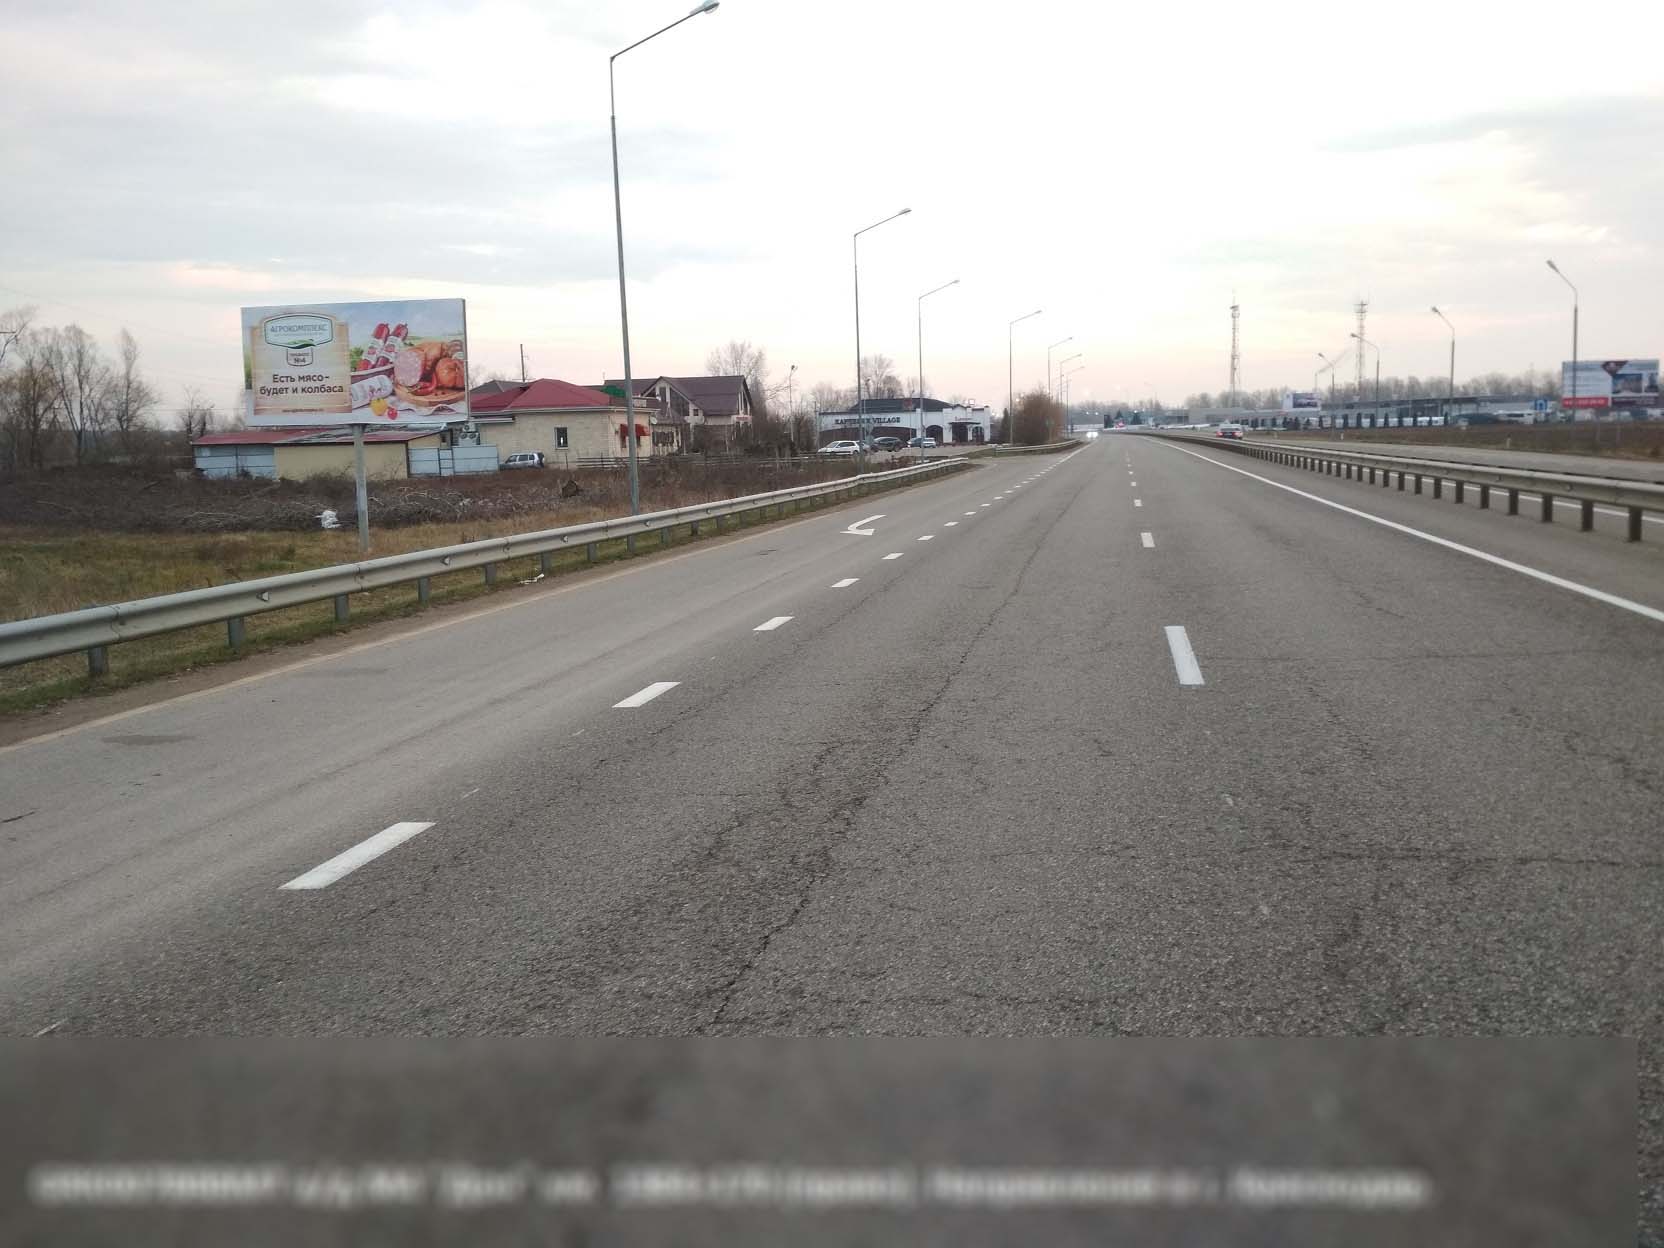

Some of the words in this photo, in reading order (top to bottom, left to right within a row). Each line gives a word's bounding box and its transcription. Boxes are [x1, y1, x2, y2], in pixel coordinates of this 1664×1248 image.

[270, 324, 328, 332] АГРОКОМПЛЕКС
[272, 374, 296, 383] Есть
[259, 386, 289, 396] будет
[301, 384, 344, 394] колбаса
